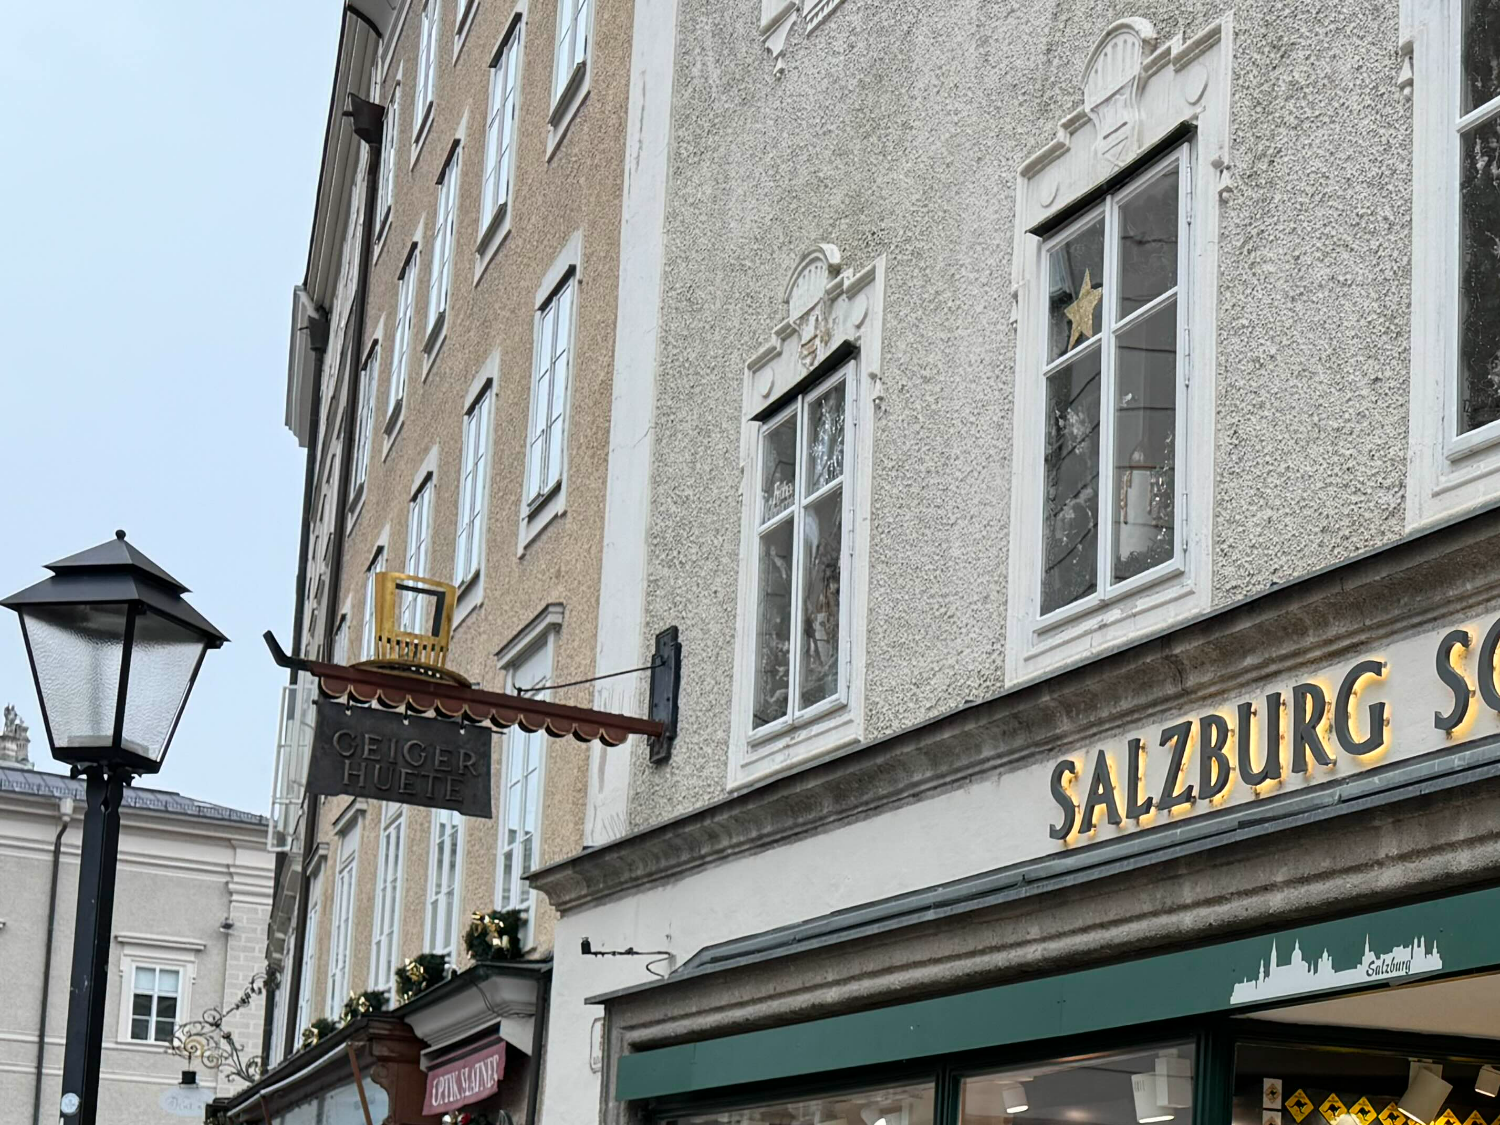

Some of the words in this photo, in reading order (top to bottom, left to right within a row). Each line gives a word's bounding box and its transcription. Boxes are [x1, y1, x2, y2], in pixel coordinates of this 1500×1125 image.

[333, 729, 479, 777] GEIGER
[1050, 660, 1387, 841] SALZBURG
[342, 759, 465, 803] HUETE
[1366, 956, 1412, 977] Salzburg
